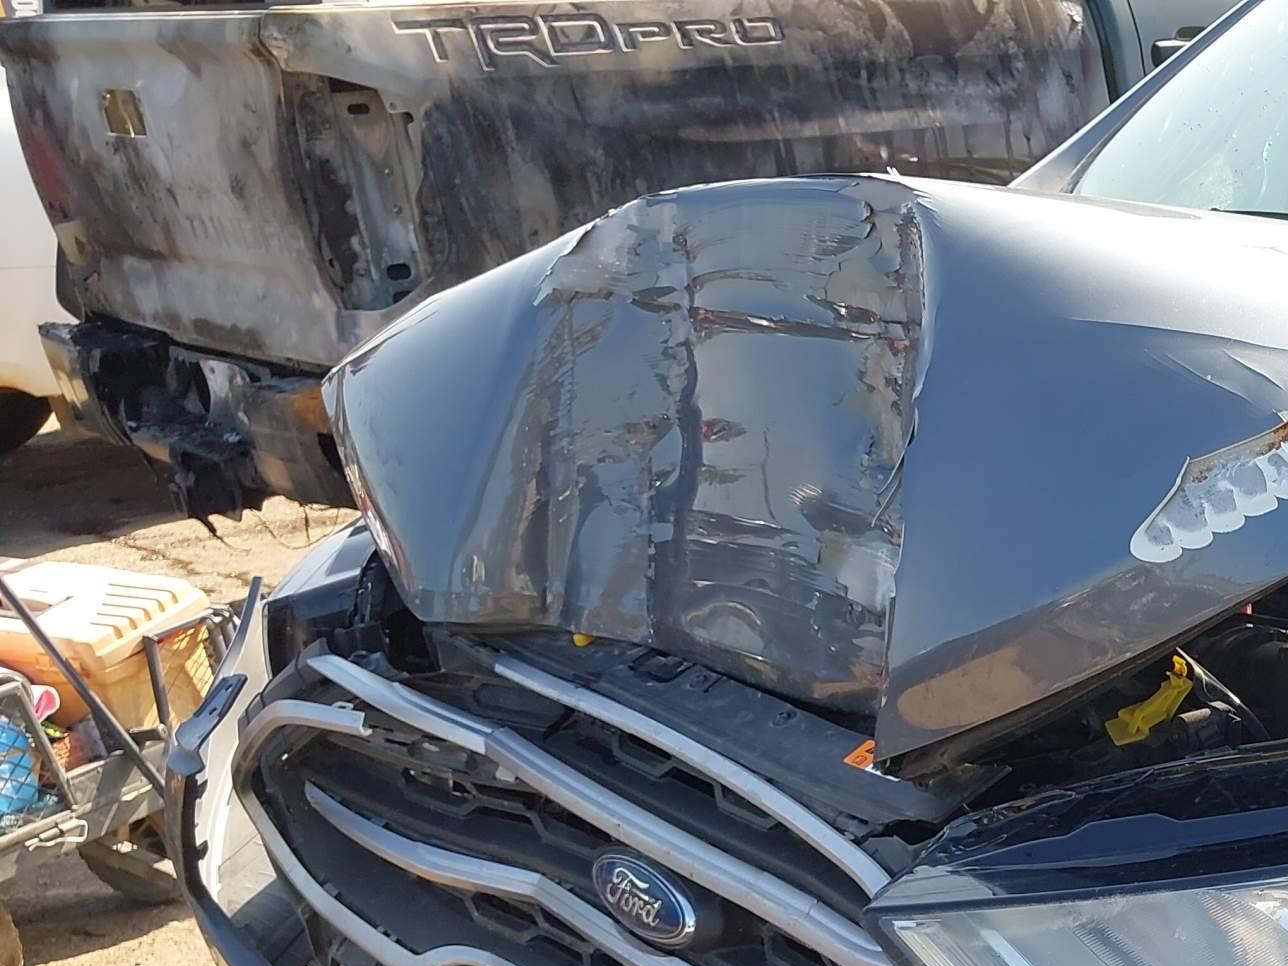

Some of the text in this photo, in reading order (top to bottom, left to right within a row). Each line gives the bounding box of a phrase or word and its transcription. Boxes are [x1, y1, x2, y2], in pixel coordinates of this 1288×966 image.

[392, 12, 786, 72] TRD PRO
[606, 866, 663, 928] Ford
